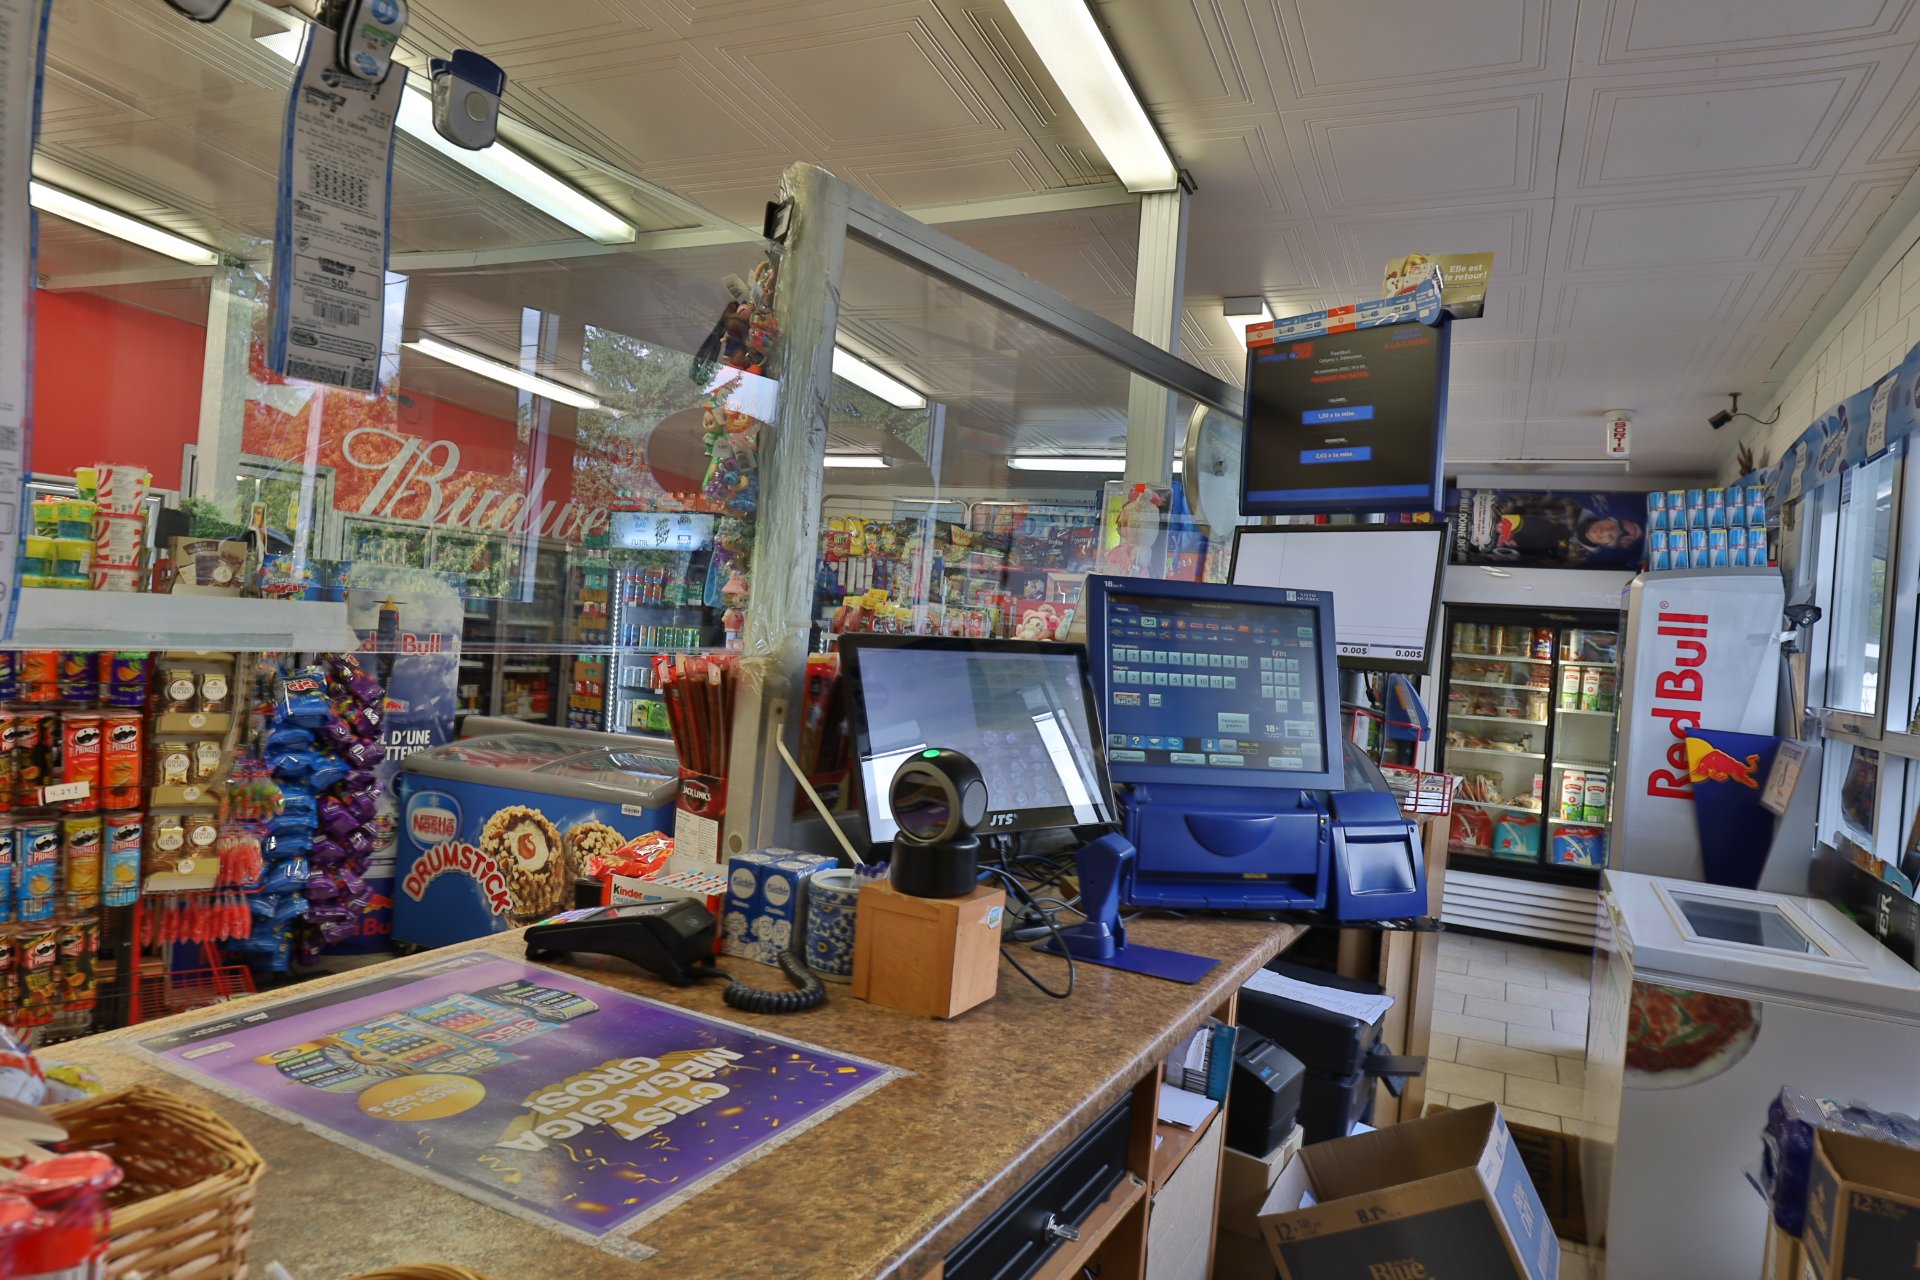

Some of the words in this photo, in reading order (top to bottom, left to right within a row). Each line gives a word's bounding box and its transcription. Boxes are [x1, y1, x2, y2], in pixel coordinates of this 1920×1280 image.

[1449, 264, 1466, 273] Elle
[1455, 271, 1488, 280] retour!
[1612, 421, 1627, 453] SORTIE
[342, 427, 609, 542] Budwe
[402, 632, 442, 656] Bull
[1342, 646, 1367, 655] 0.00$
[1395, 650, 1422, 658] 0.00$
[1655, 612, 1709, 701] Bull
[391, 729, 431, 745] D'UNE
[112, 742, 138, 752] PRINGLES
[1647, 707, 1701, 800] Red
[990, 813, 1014, 827] JTS
[116, 839, 141, 849] PRINGLES
[403, 842, 512, 915] DRUMSTICK
[613, 883, 643, 900] Kinder
[608, 1082, 731, 1141] C'EST
[1274, 1219, 1296, 1242] 12
